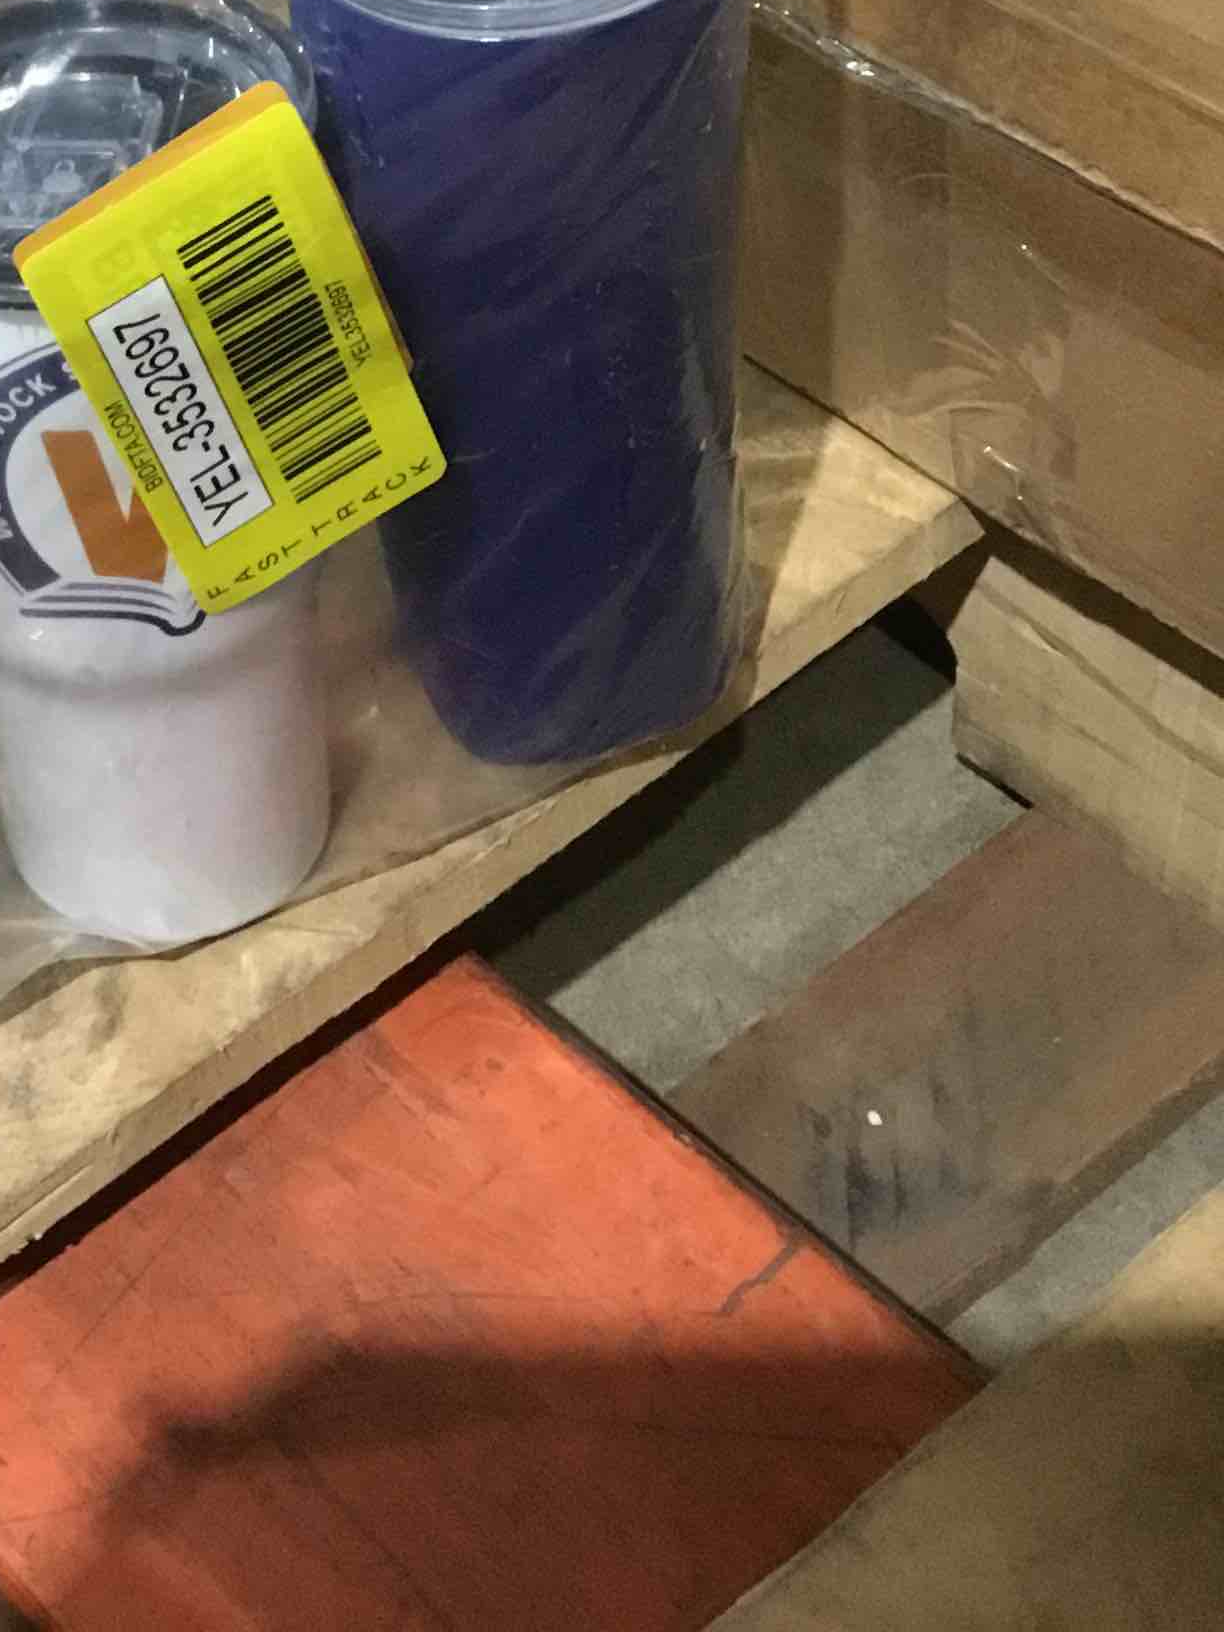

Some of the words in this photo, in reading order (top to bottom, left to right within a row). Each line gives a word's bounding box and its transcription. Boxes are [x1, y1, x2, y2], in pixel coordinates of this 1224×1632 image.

[105, 399, 164, 494] BIDFTA.COM
[113, 312, 249, 527] YEL-3532697
[206, 538, 302, 600] FAST
[310, 455, 432, 537] TRACK
